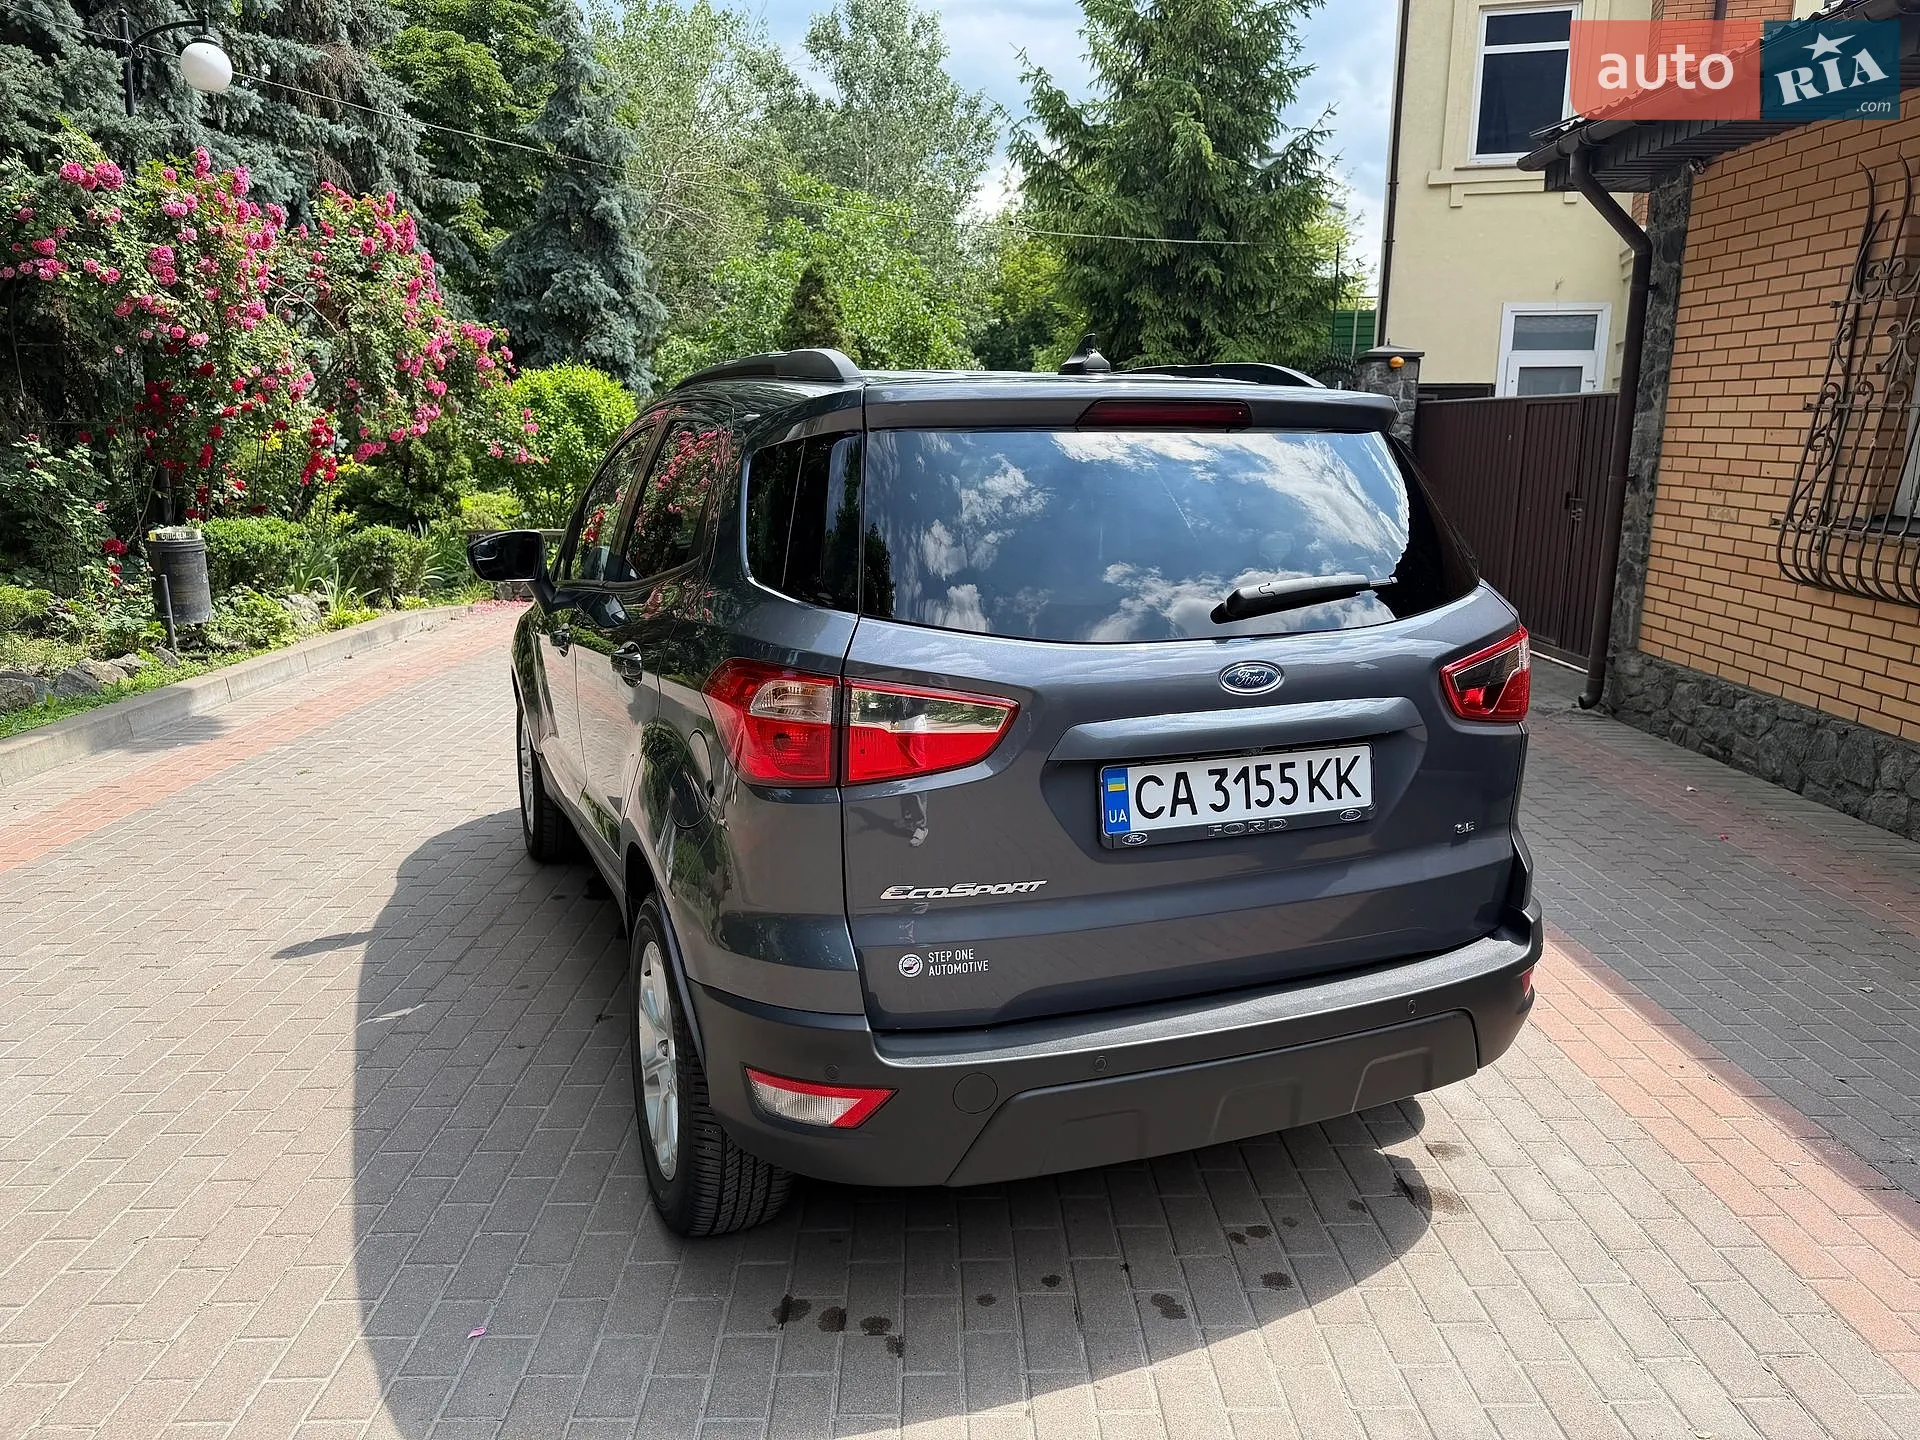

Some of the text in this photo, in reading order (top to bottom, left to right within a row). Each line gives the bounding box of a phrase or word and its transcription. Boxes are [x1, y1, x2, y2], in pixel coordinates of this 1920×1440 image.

[1135, 755, 1362, 820] CA 3155 KK
[1108, 809, 1128, 824] UA
[1207, 818, 1288, 837] FORD
[928, 948, 974, 963] STEP ONE
[928, 960, 989, 976] AUTOMOTIVE
